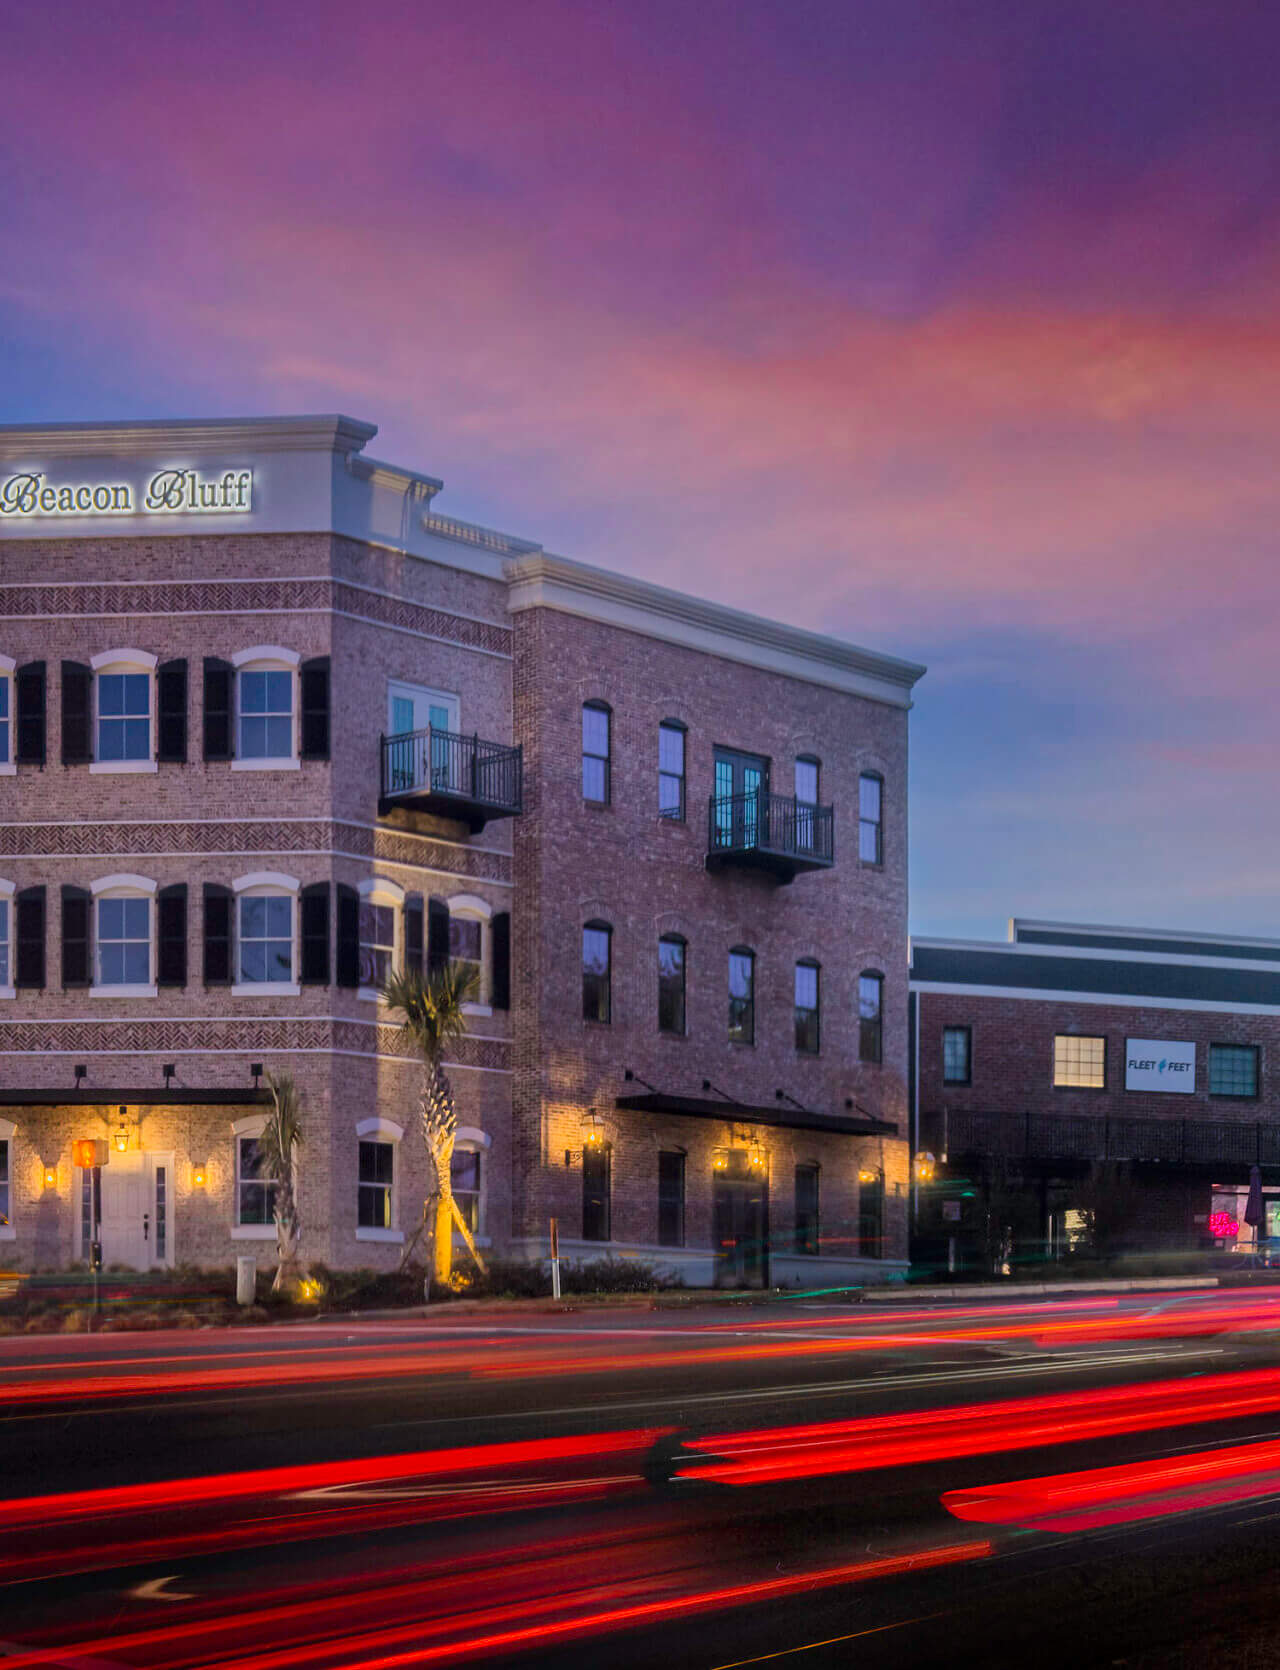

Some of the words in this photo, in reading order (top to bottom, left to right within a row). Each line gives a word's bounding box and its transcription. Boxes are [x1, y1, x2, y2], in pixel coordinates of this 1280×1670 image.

[0, 473, 132, 514] Beacon
[145, 469, 250, 510] Bluff
[1128, 1060, 1156, 1071] FLEET
[1168, 1062, 1192, 1072] FEET
